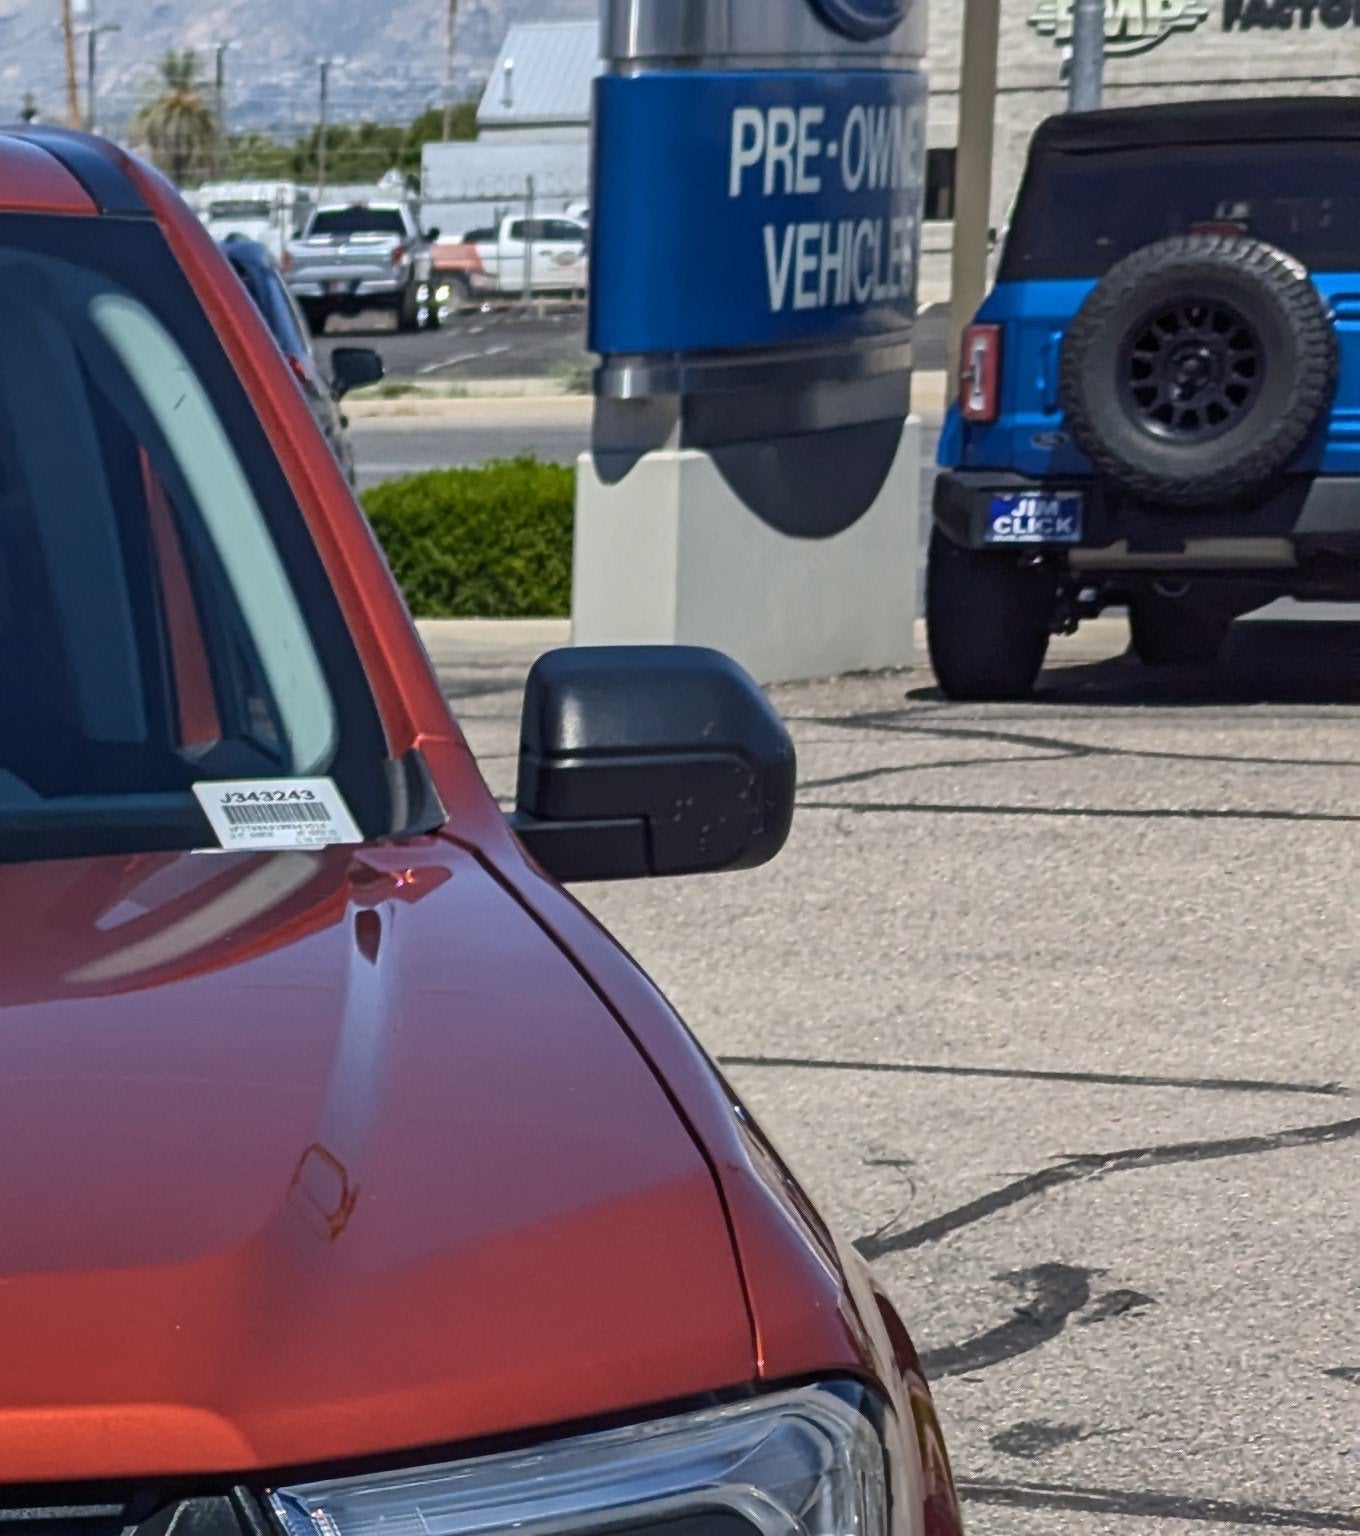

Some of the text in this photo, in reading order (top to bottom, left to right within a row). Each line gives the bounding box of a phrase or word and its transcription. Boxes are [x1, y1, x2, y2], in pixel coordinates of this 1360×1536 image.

[1222, 0, 1360, 32] FACTO
[729, 104, 926, 197] PRE-OWNE
[1010, 498, 1059, 517] JIM
[992, 515, 1074, 534] CLICK
[220, 789, 316, 804] J343243
